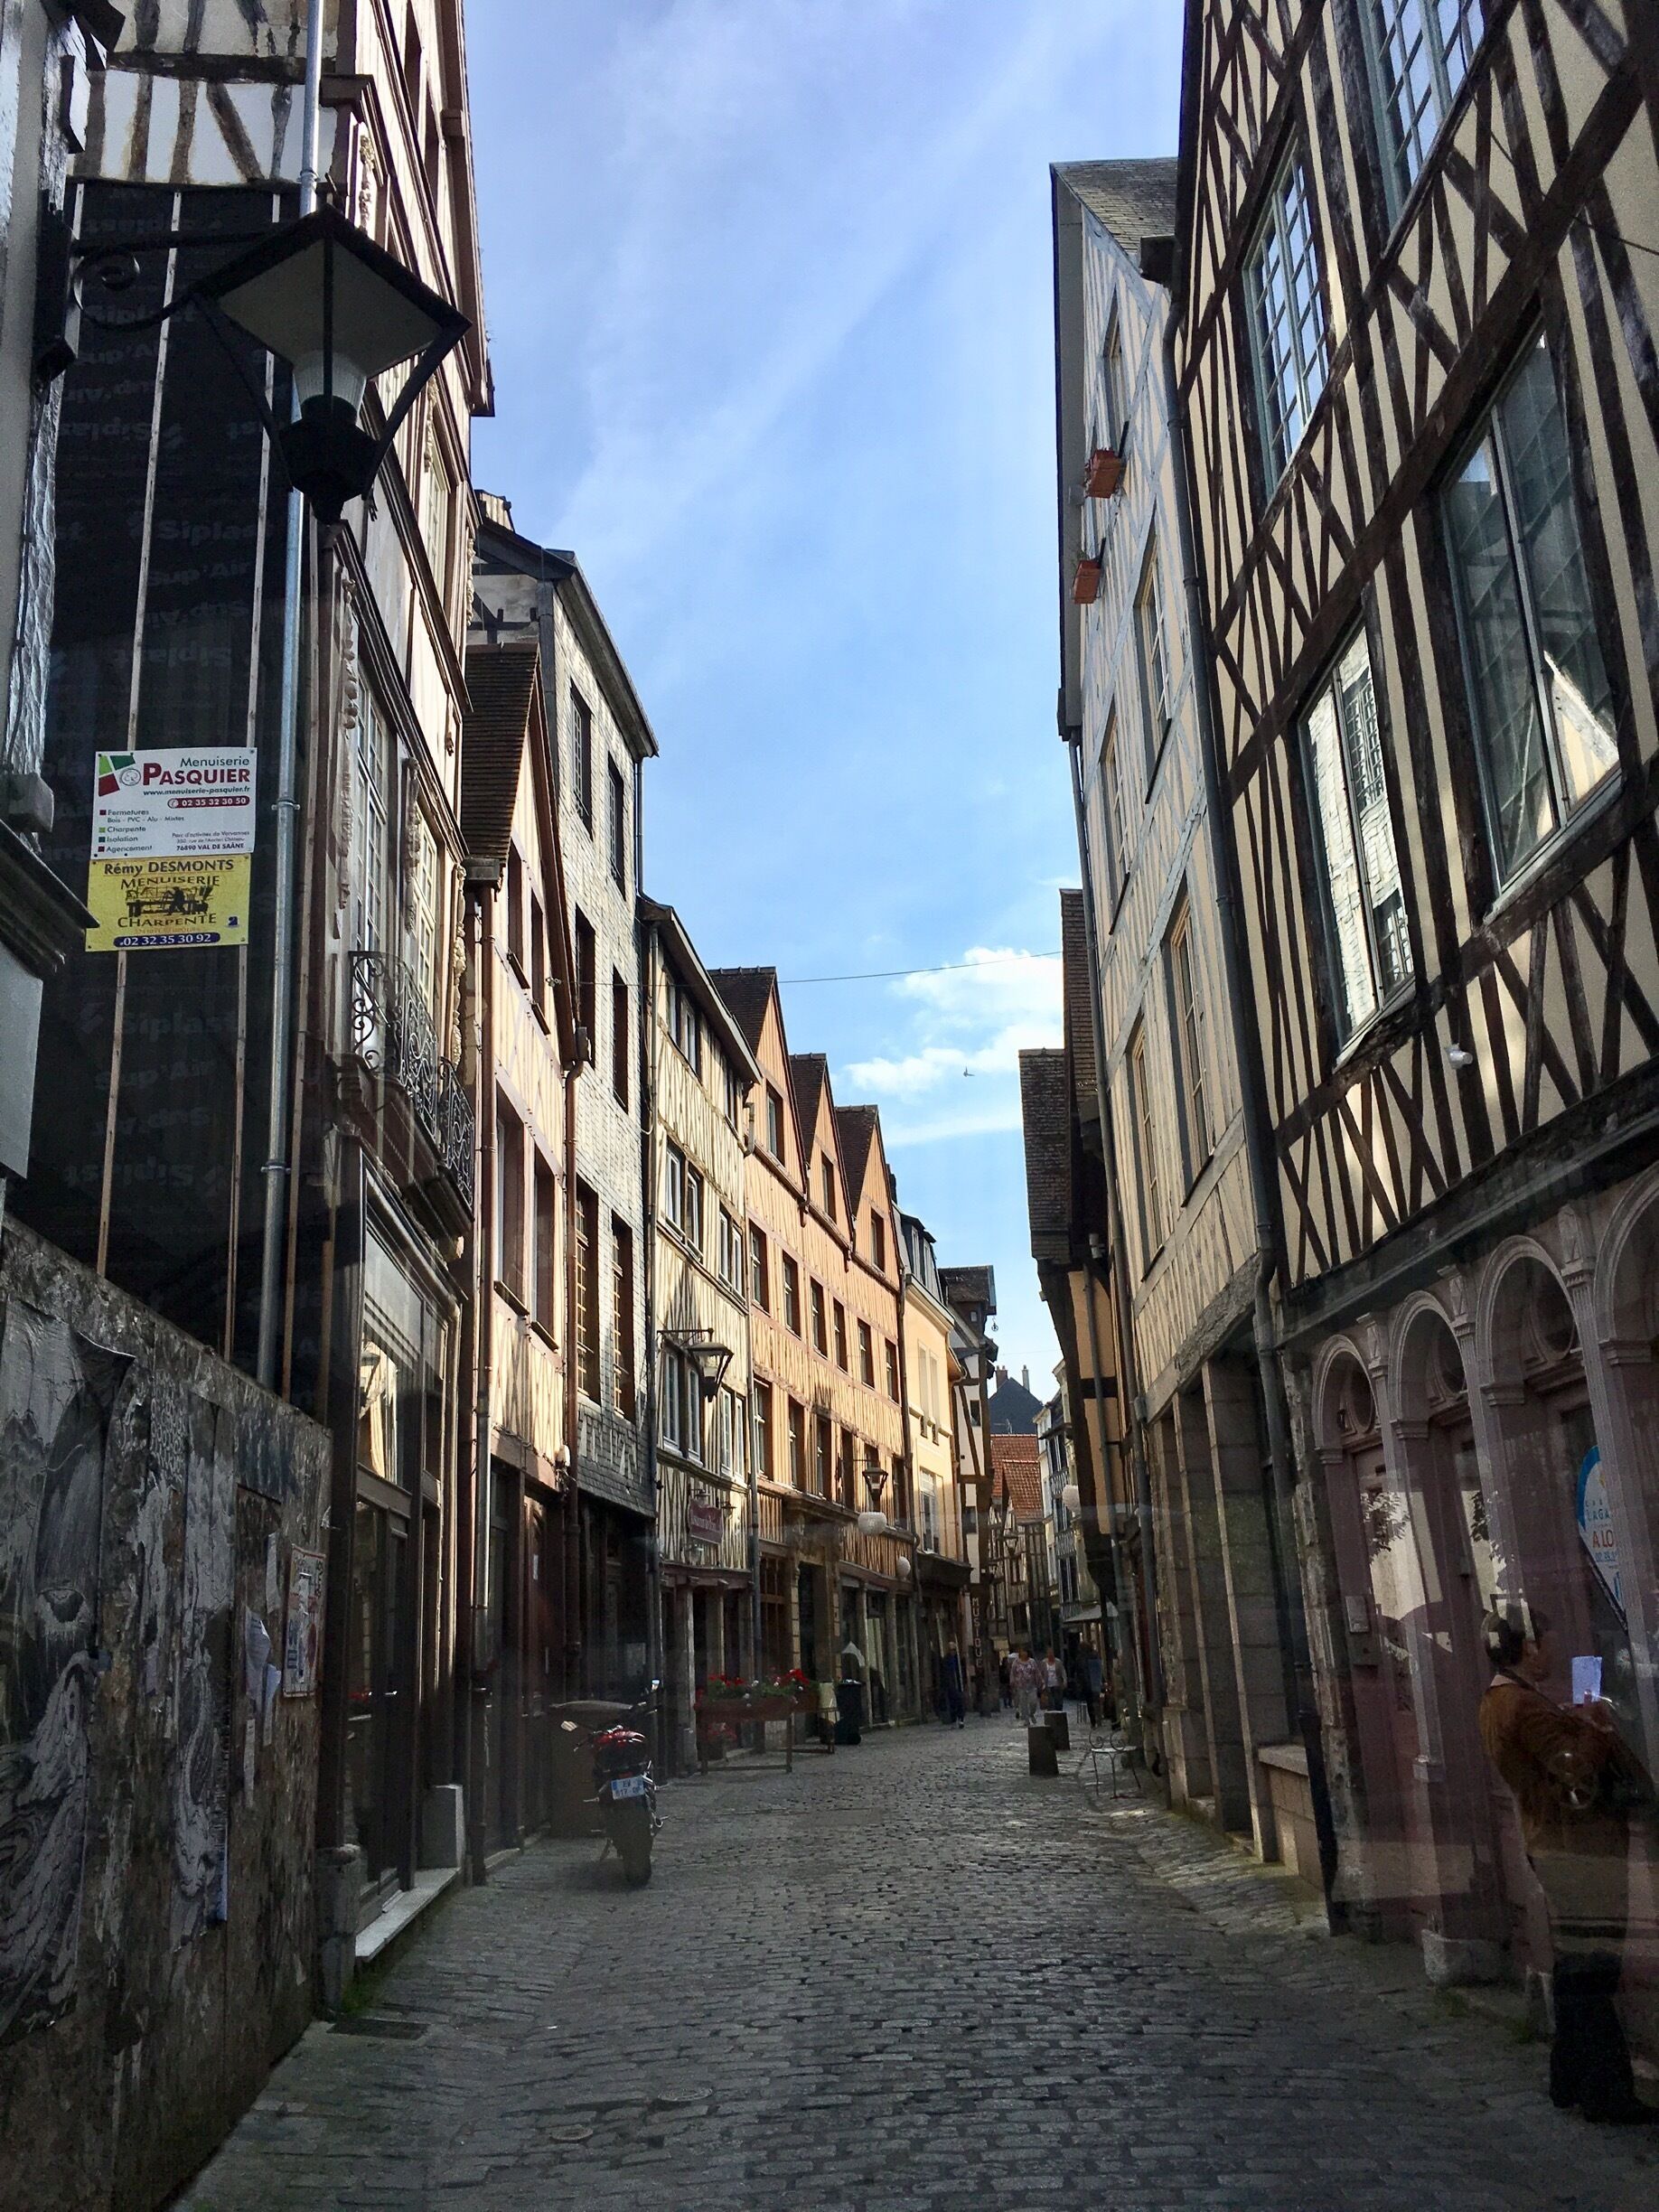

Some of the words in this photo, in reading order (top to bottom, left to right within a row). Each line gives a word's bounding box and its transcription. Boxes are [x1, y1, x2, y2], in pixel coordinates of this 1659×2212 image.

[180, 755, 250, 768] Menuiserie
[143, 762, 251, 786] PASQUIER
[143, 786, 250, 796] www.menuiserie-pasquier.fr
[104, 863, 144, 877] Rémy
[149, 859, 234, 873] DESMONTS
[120, 875, 220, 890] MENUISERIE
[117, 913, 217, 928] CHARPENTE
[123, 936, 143, 946] 02
[142, 935, 158, 945] 32
[159, 934, 176, 944] 35
[177, 934, 194, 943] 30
[196, 933, 212, 942] 92
[1592, 1530, 1600, 1548] A
[971, 1597, 983, 1668] MUSIQUE
